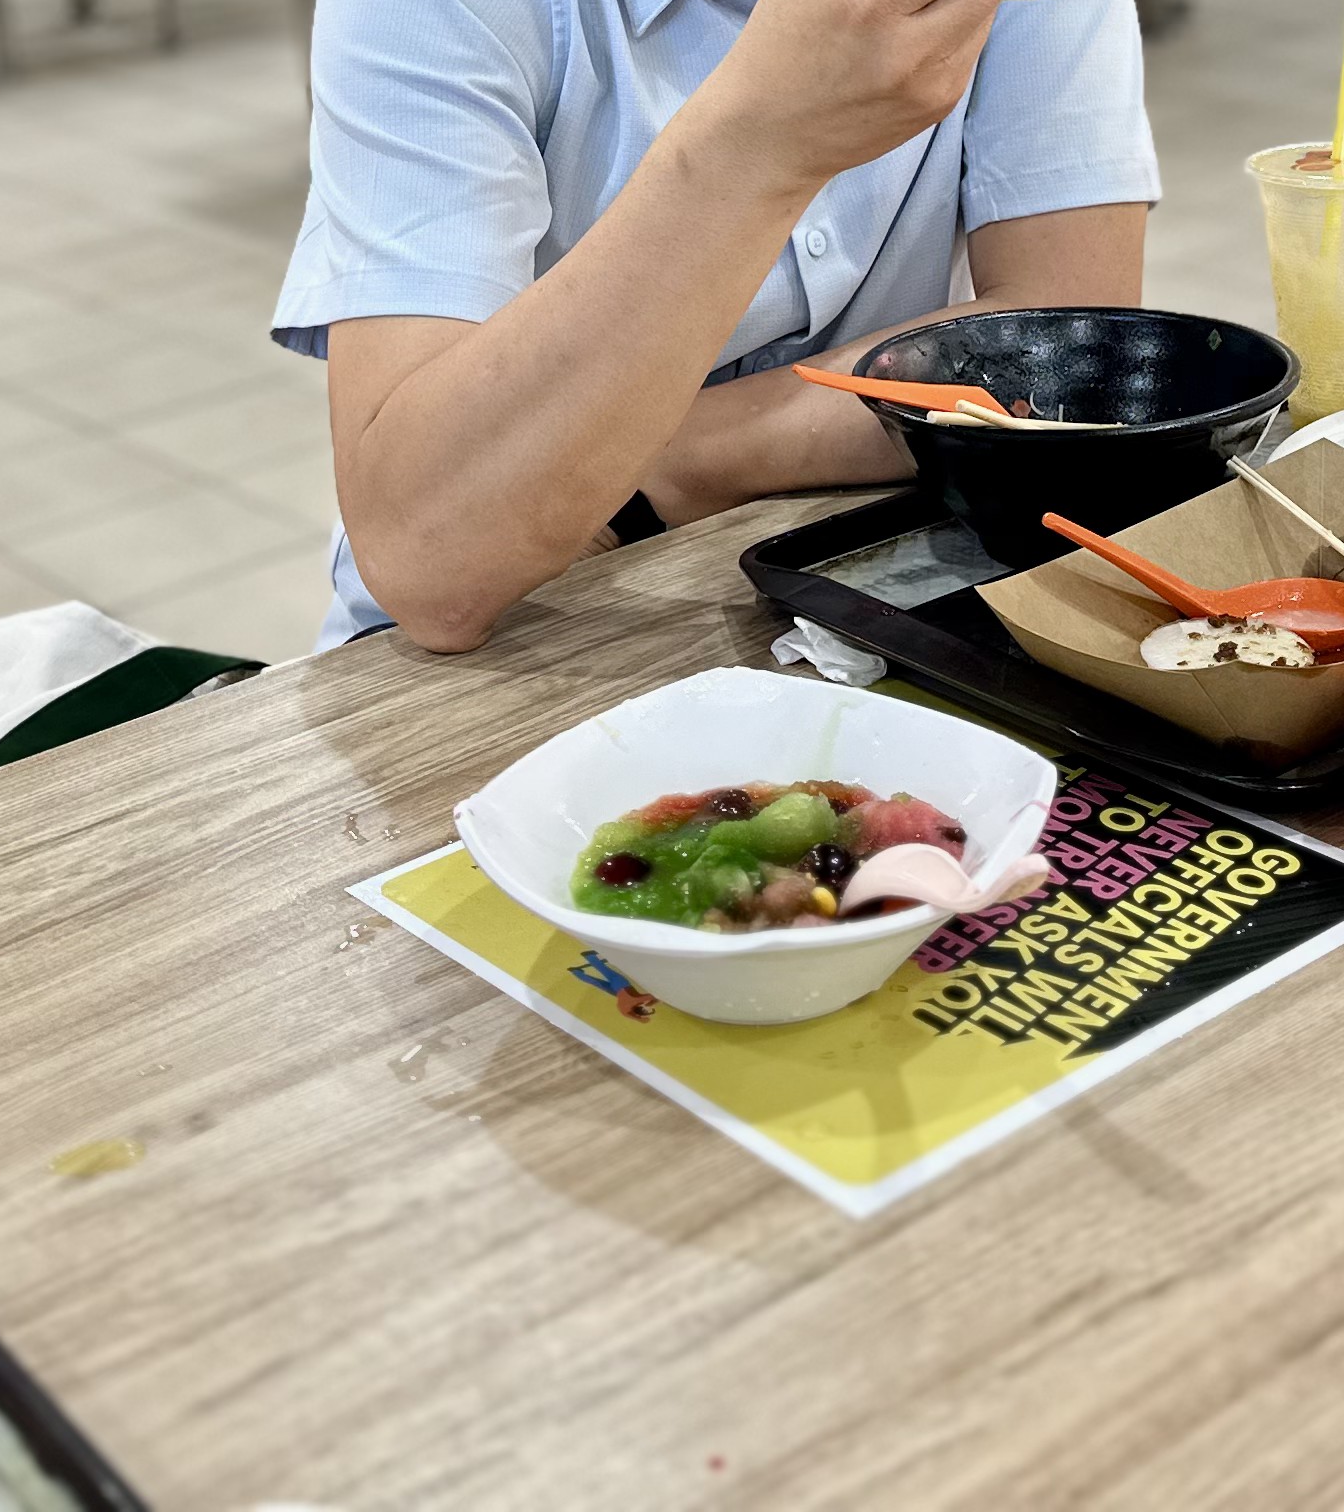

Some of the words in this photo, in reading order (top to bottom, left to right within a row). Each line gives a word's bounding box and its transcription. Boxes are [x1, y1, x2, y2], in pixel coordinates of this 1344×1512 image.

[1099, 794, 1171, 832] TO
[1073, 809, 1214, 900] NEVER
[988, 891, 1091, 966] ASK
[1054, 830, 1254, 973] OFFICIALS
[1026, 849, 1301, 1062] GOVERNMENT
[909, 960, 1017, 1036] YOU
[947, 969, 1078, 1045] WILL
